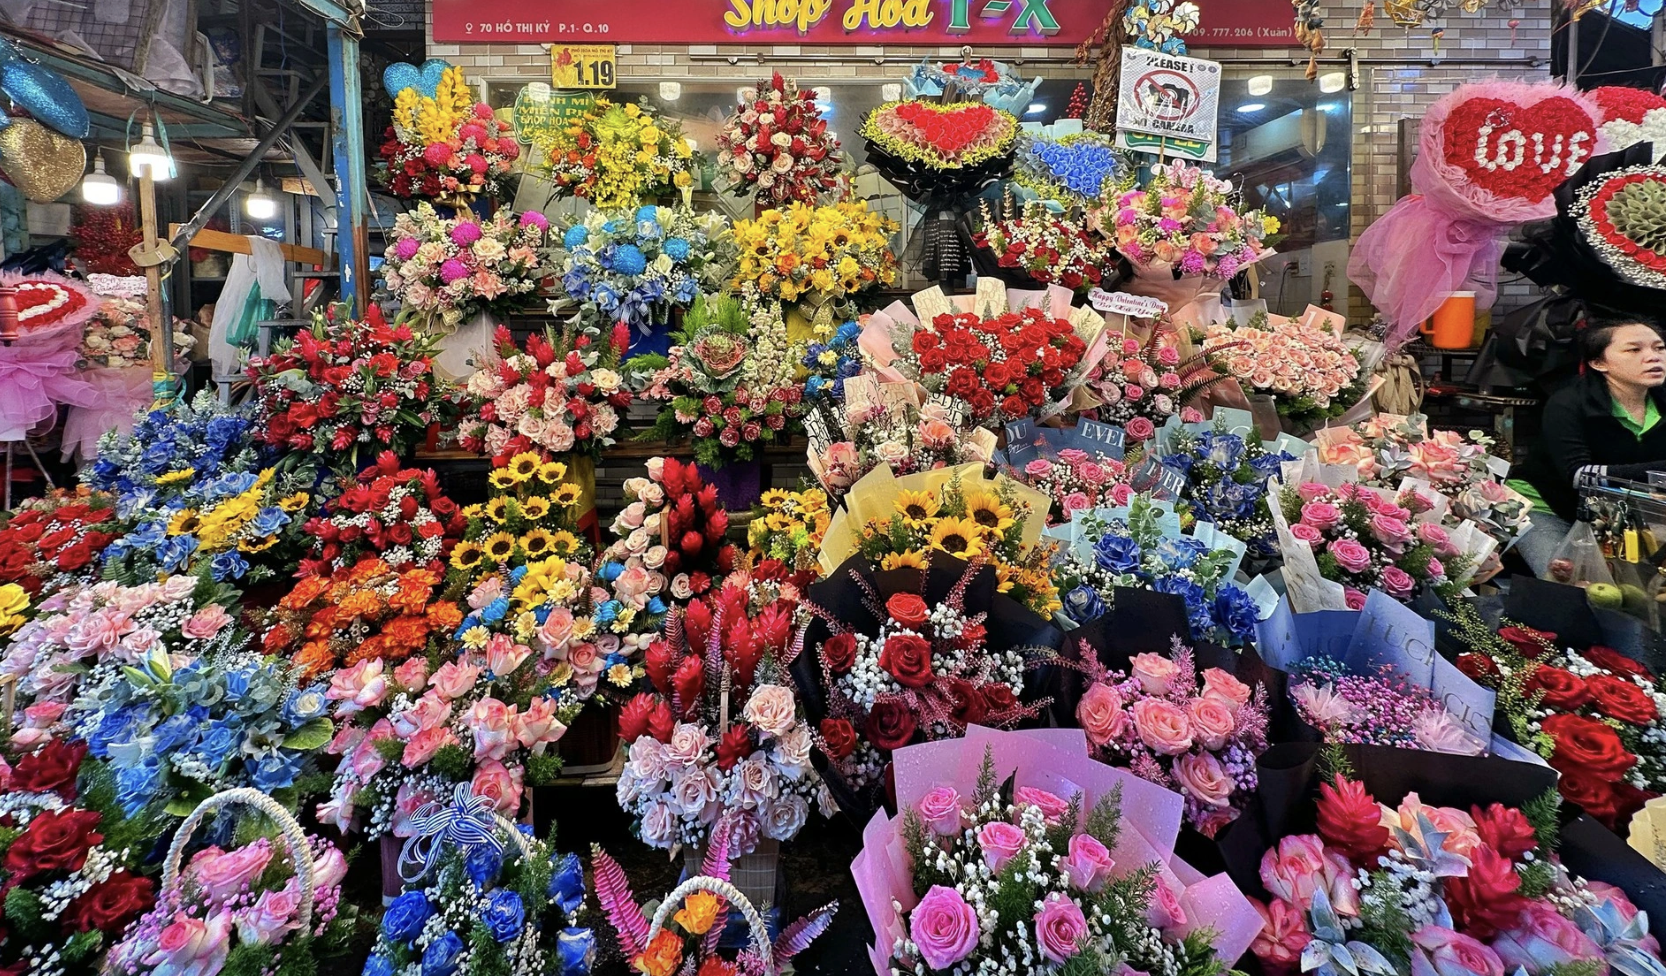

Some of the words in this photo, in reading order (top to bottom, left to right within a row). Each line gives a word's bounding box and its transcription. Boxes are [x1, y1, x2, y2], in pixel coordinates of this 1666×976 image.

[724, 0, 831, 33] Shop
[842, 0, 934, 30] Hoa
[479, 23, 492, 33] 70
[515, 23, 533, 35] THỊ
[1257, 27, 1292, 37] (Xuân)
[574, 60, 613, 86] 1.19
[549, 116, 569, 126] HOA
[1474, 125, 1590, 177] LOVE
[1092, 290, 1114, 302] Happy
[1115, 294, 1149, 308] Valentine's
